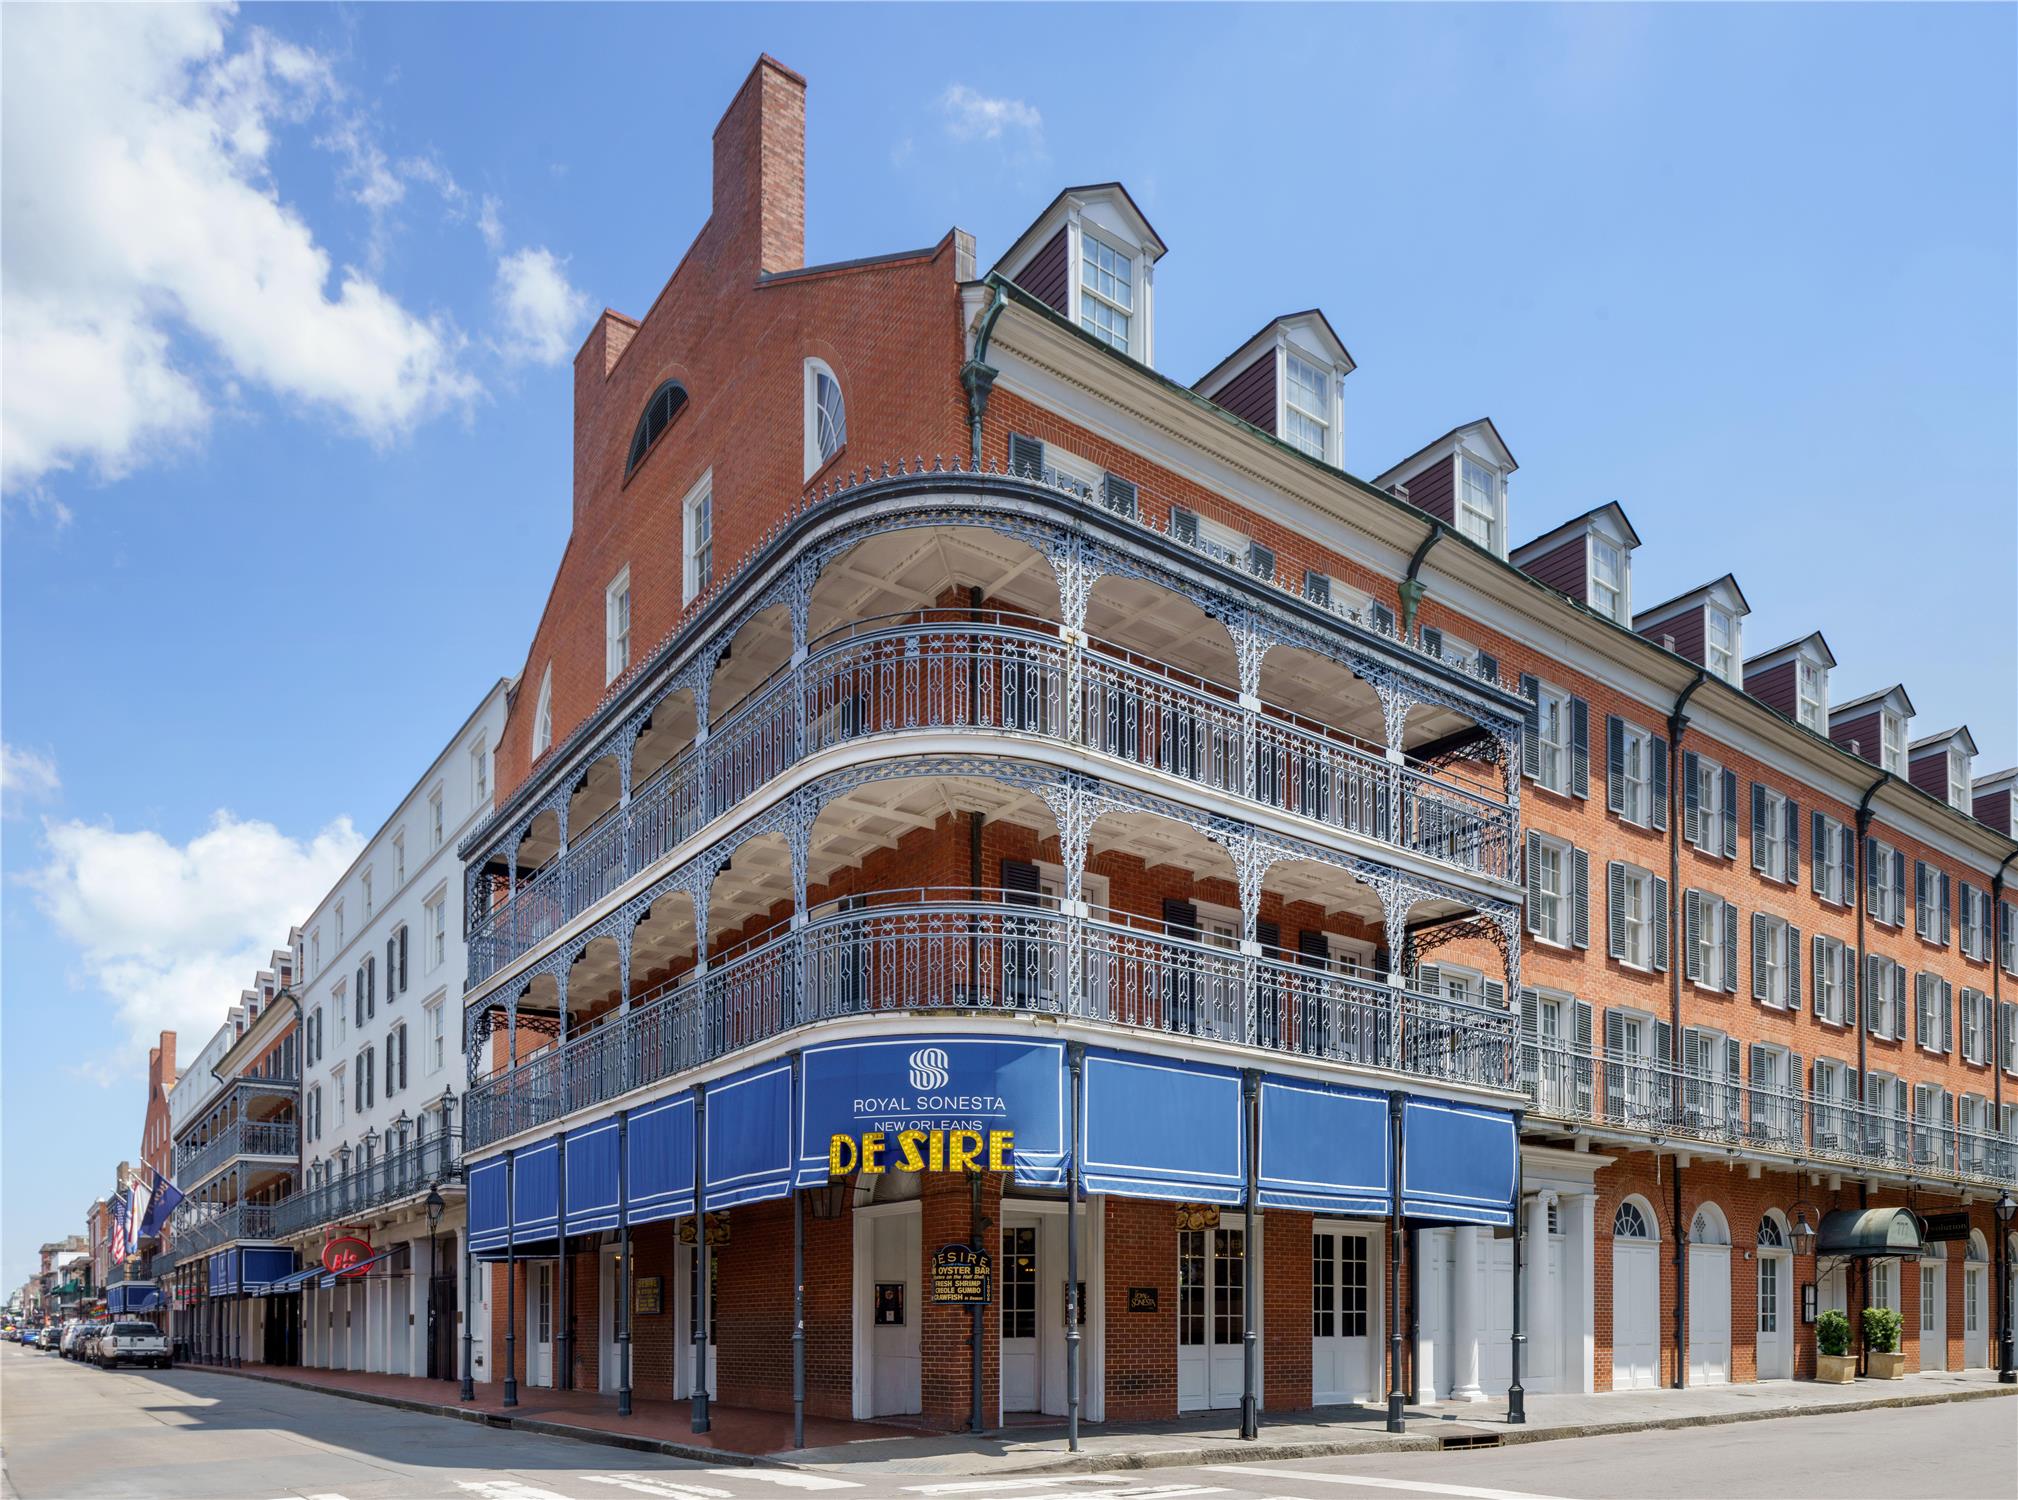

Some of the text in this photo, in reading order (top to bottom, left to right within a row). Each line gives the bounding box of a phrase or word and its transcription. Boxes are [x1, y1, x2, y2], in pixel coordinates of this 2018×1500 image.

[854, 1096, 1006, 1113] ROYAL SONESTA
[874, 1120, 983, 1132] NEW ORLEANS
[829, 1129, 1015, 1176] DESIRE
[932, 1252, 988, 1267] DESIRE
[938, 1267, 971, 1275] OYSTER
[974, 1267, 990, 1275] BAR
